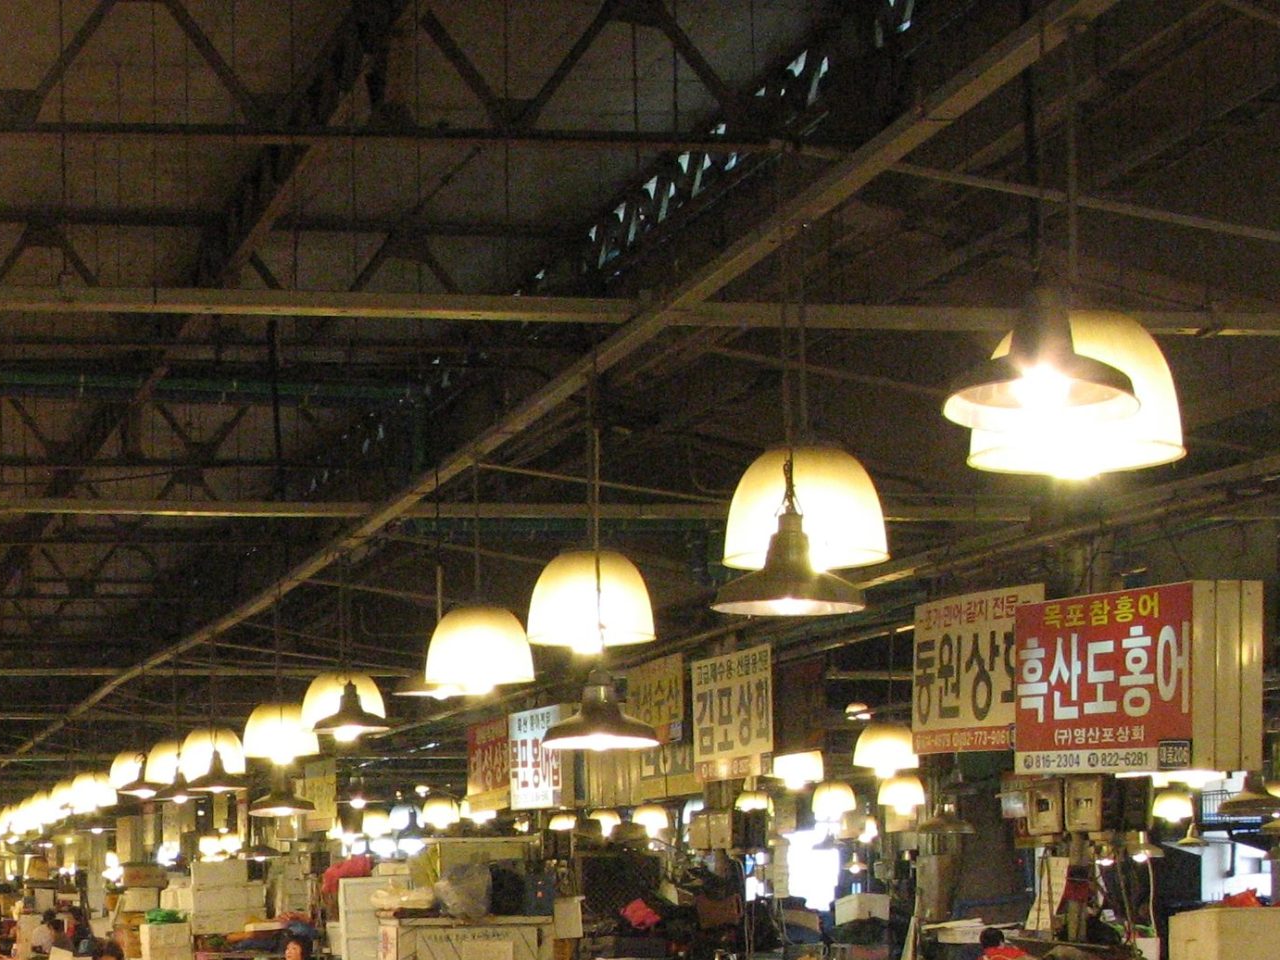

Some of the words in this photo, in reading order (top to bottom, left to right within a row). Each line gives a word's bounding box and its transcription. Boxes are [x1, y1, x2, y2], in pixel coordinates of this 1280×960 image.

[992, 594, 1018, 619] 전문
[1043, 591, 1160, 629] 목포참홍어
[1017, 620, 1190, 724] 흑산도홍어
[695, 677, 770, 756] 김포상회
